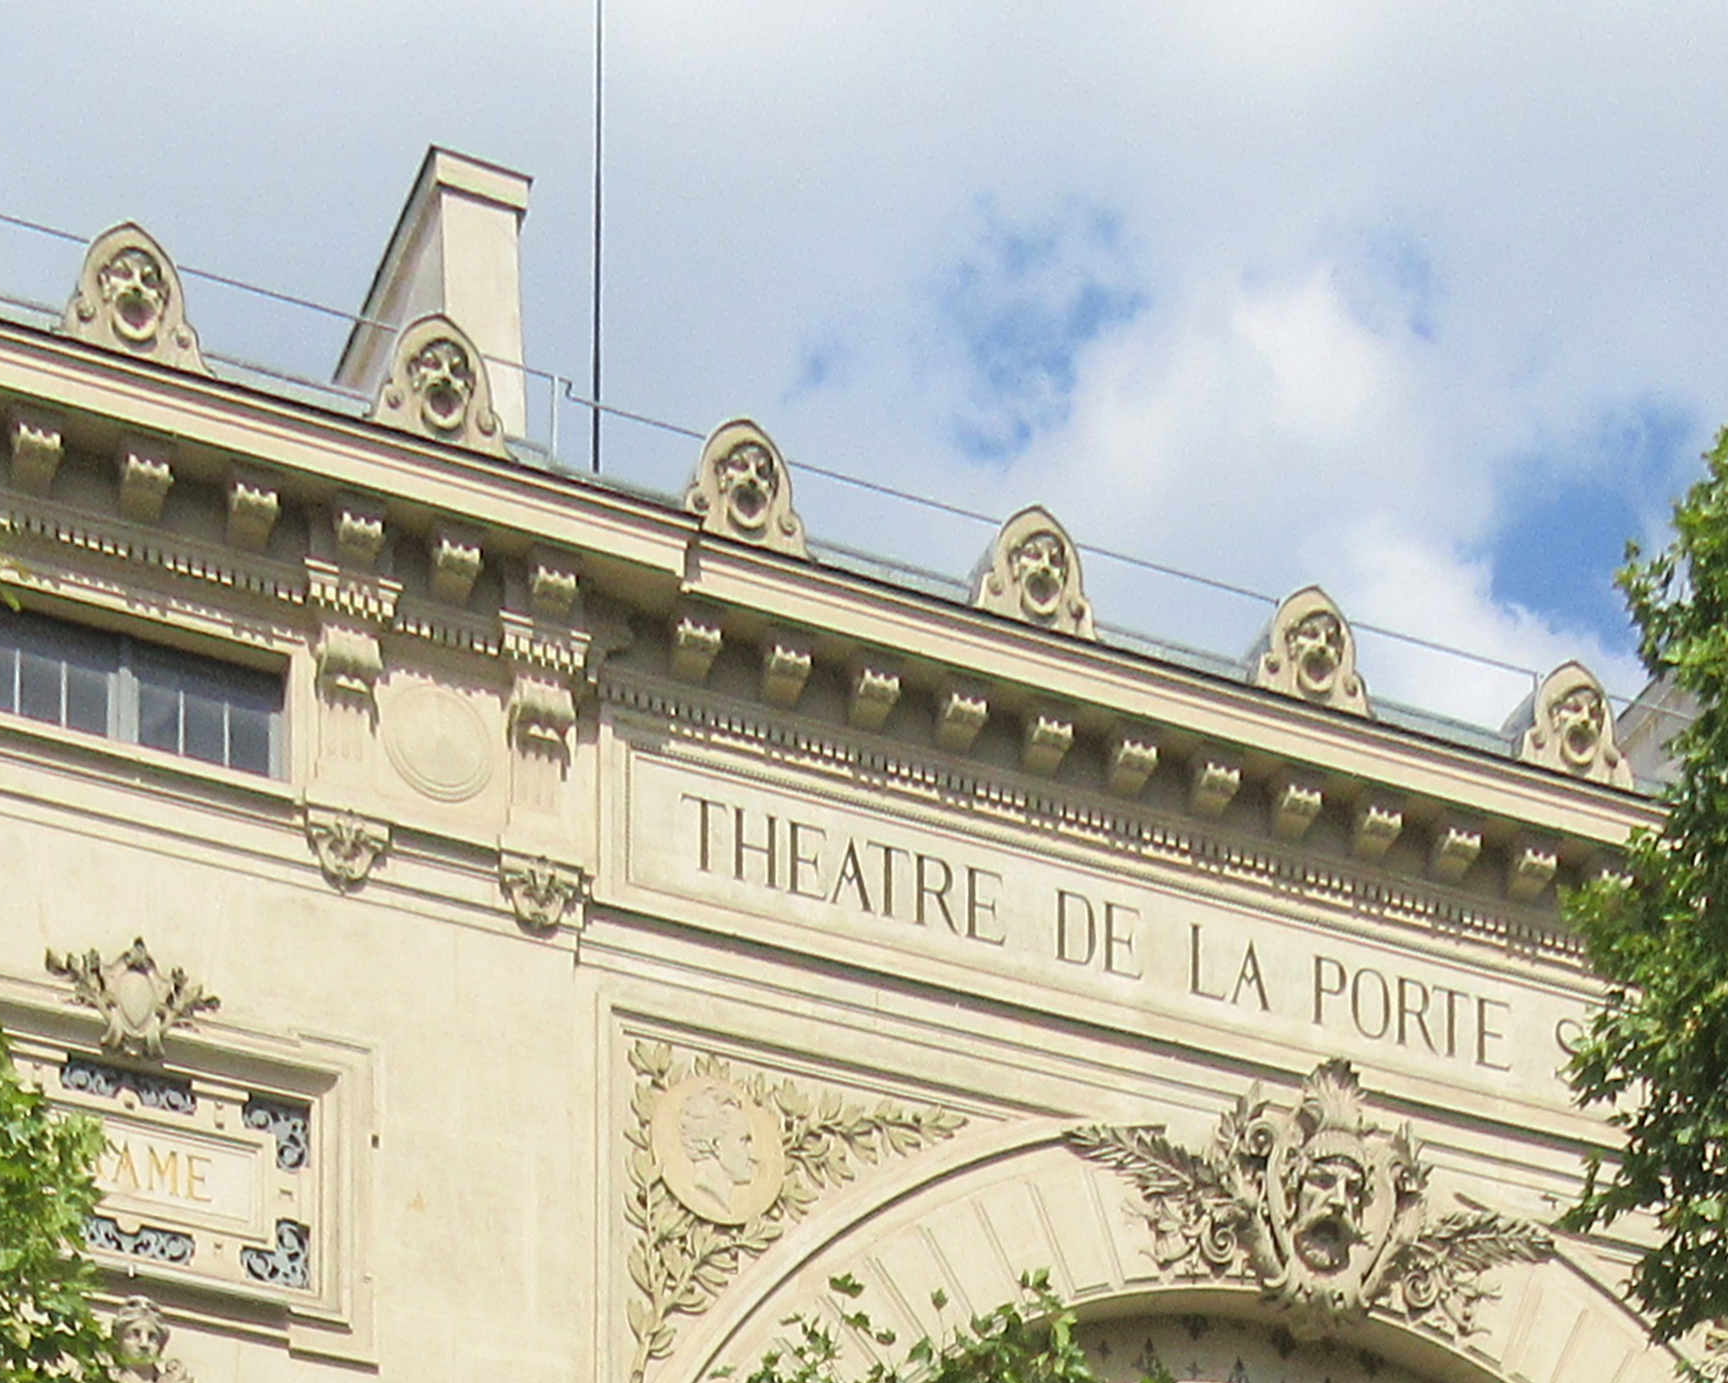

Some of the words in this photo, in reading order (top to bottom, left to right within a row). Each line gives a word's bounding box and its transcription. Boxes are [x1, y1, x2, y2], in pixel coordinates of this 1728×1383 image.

[681, 794, 1007, 948] THEATRE
[1055, 888, 1142, 981] DE
[1186, 922, 1272, 1012] LA
[1313, 953, 1513, 1072] PORTE
